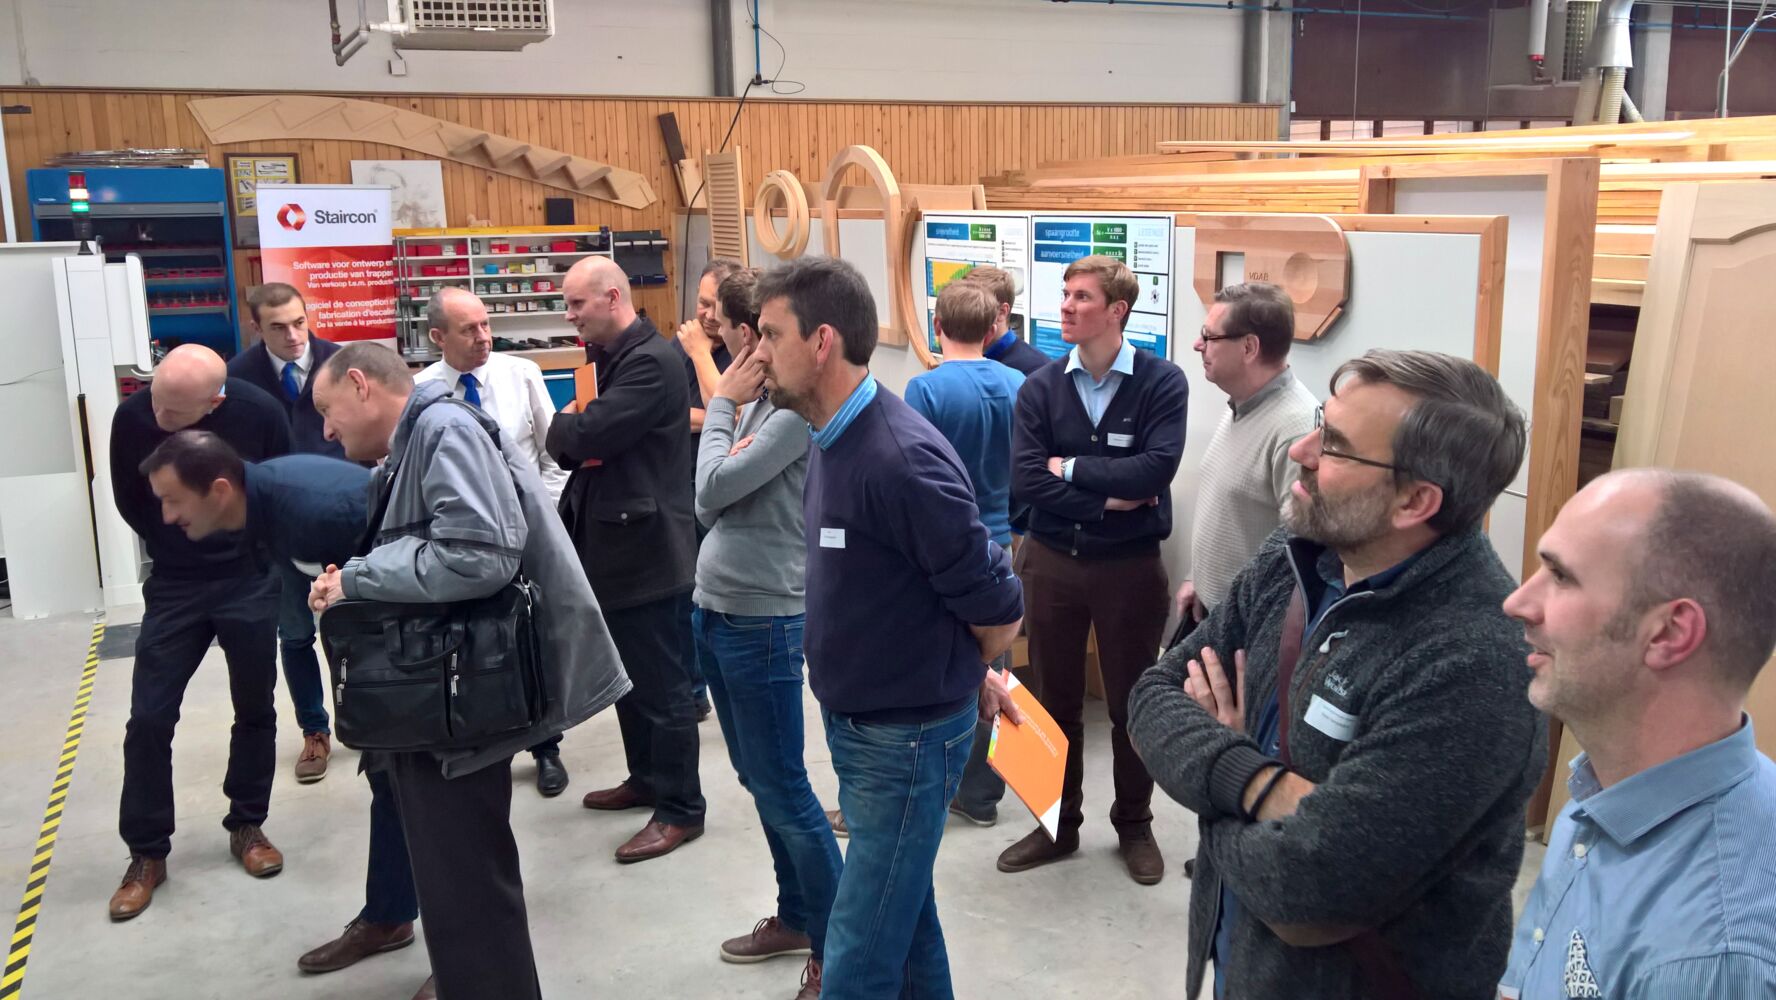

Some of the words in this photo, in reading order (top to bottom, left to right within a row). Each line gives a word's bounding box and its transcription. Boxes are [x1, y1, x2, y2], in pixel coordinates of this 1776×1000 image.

[314, 209, 376, 224] Staircon
[293, 261, 330, 270] Software
[352, 260, 385, 269] ontwerp
[309, 270, 348, 281] productie
[321, 281, 347, 289] verkoop
[367, 278, 394, 287] producti
[306, 301, 332, 311] ogiciel
[333, 300, 343, 308] de
[345, 298, 388, 307] conception
[319, 311, 361, 320] fabrication
[366, 317, 396, 326] productio
